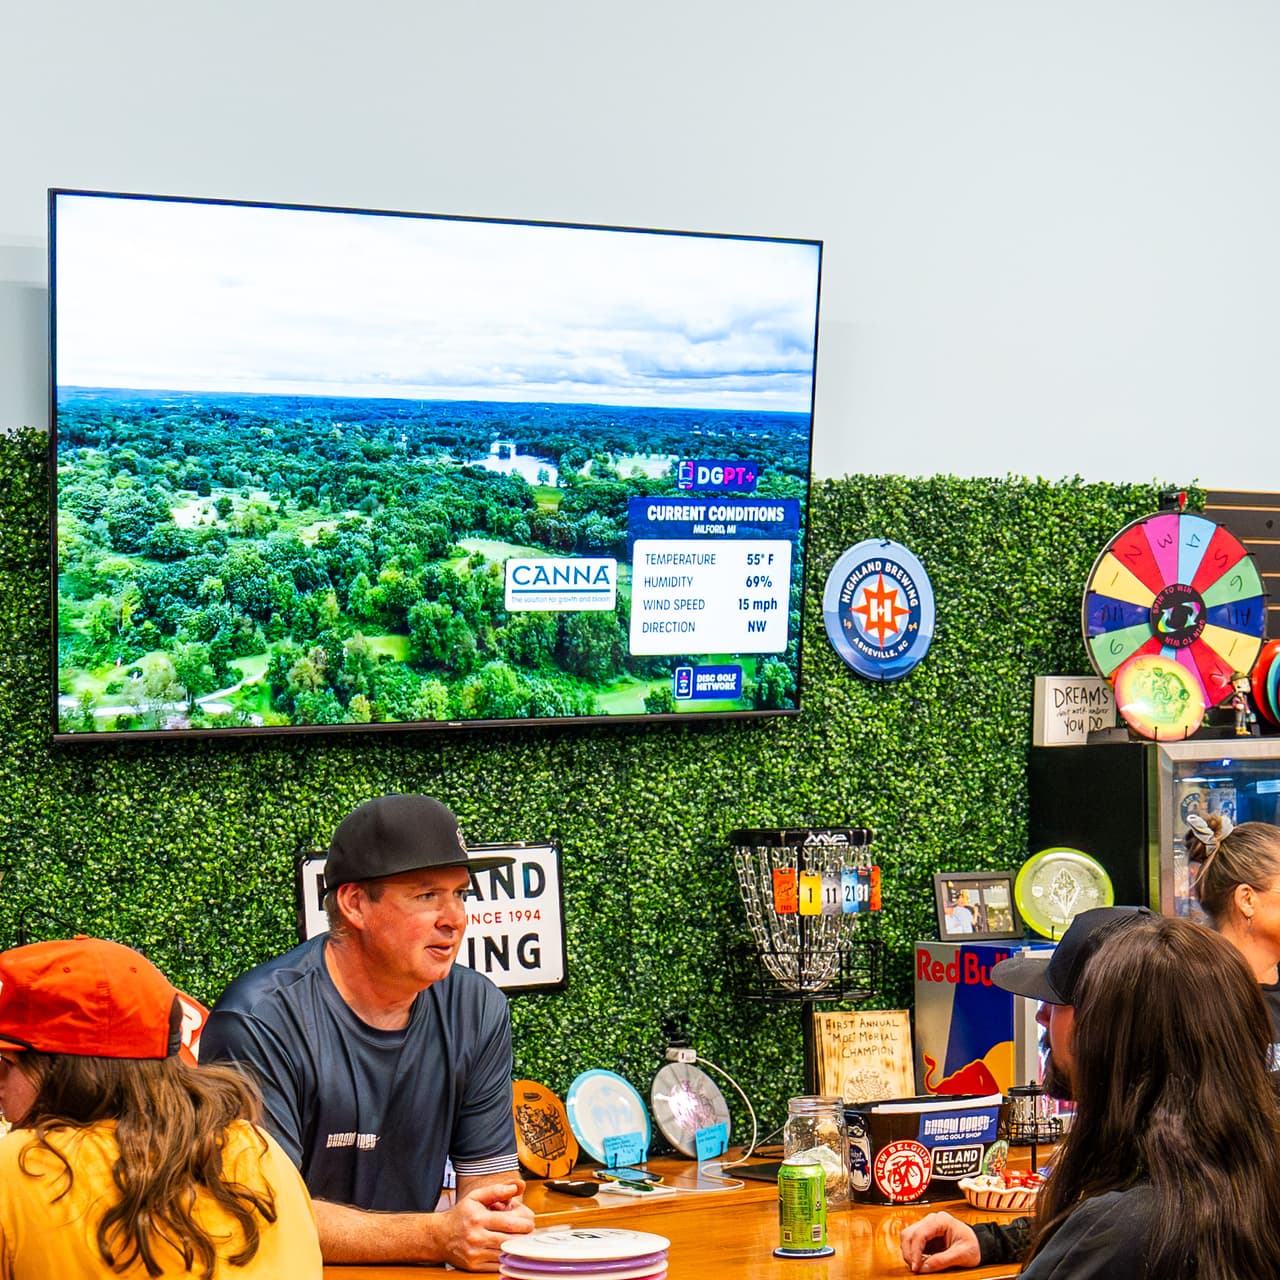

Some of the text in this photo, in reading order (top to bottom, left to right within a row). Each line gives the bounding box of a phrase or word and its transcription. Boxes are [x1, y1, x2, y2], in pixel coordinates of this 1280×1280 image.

[647, 505, 784, 522] CURRENT CONDITIONS
[727, 525, 736, 534] MI
[1157, 534, 1173, 549] 3
[1186, 533, 1201, 549] 4
[645, 553, 716, 565] TEMPERATURE
[768, 554, 774, 566] F
[512, 565, 610, 585] CANNA
[644, 576, 773, 588] HUMIDITY 69%
[841, 561, 918, 607] HIGHLAND BREWING
[643, 598, 777, 613] WIND SPEED 15 mph
[1153, 586, 1192, 615] SPIN TO WIN
[870, 598, 892, 622] H
[642, 621, 767, 633] DIRECTION NW
[843, 619, 852, 629] 19
[696, 673, 736, 683] DISC GOLF
[696, 682, 736, 691] NETWORK
[1054, 686, 1109, 708] DREAMS
[1064, 717, 1102, 736] YOU DO
[808, 888, 813, 903] 1
[826, 888, 836, 904] 11
[845, 886, 855, 901] 21
[858, 884, 868, 901] 31
[466, 910, 541, 925] INCE 1994
[917, 949, 1008, 987] Red Bu
[826, 1018, 899, 1030] FIRST ANNUAL
[842, 1045, 894, 1058] CHAMPION
[878, 1155, 888, 1177] NEW
[889, 1143, 930, 1170] BELGIUM
[936, 1150, 979, 1164] LELAND
